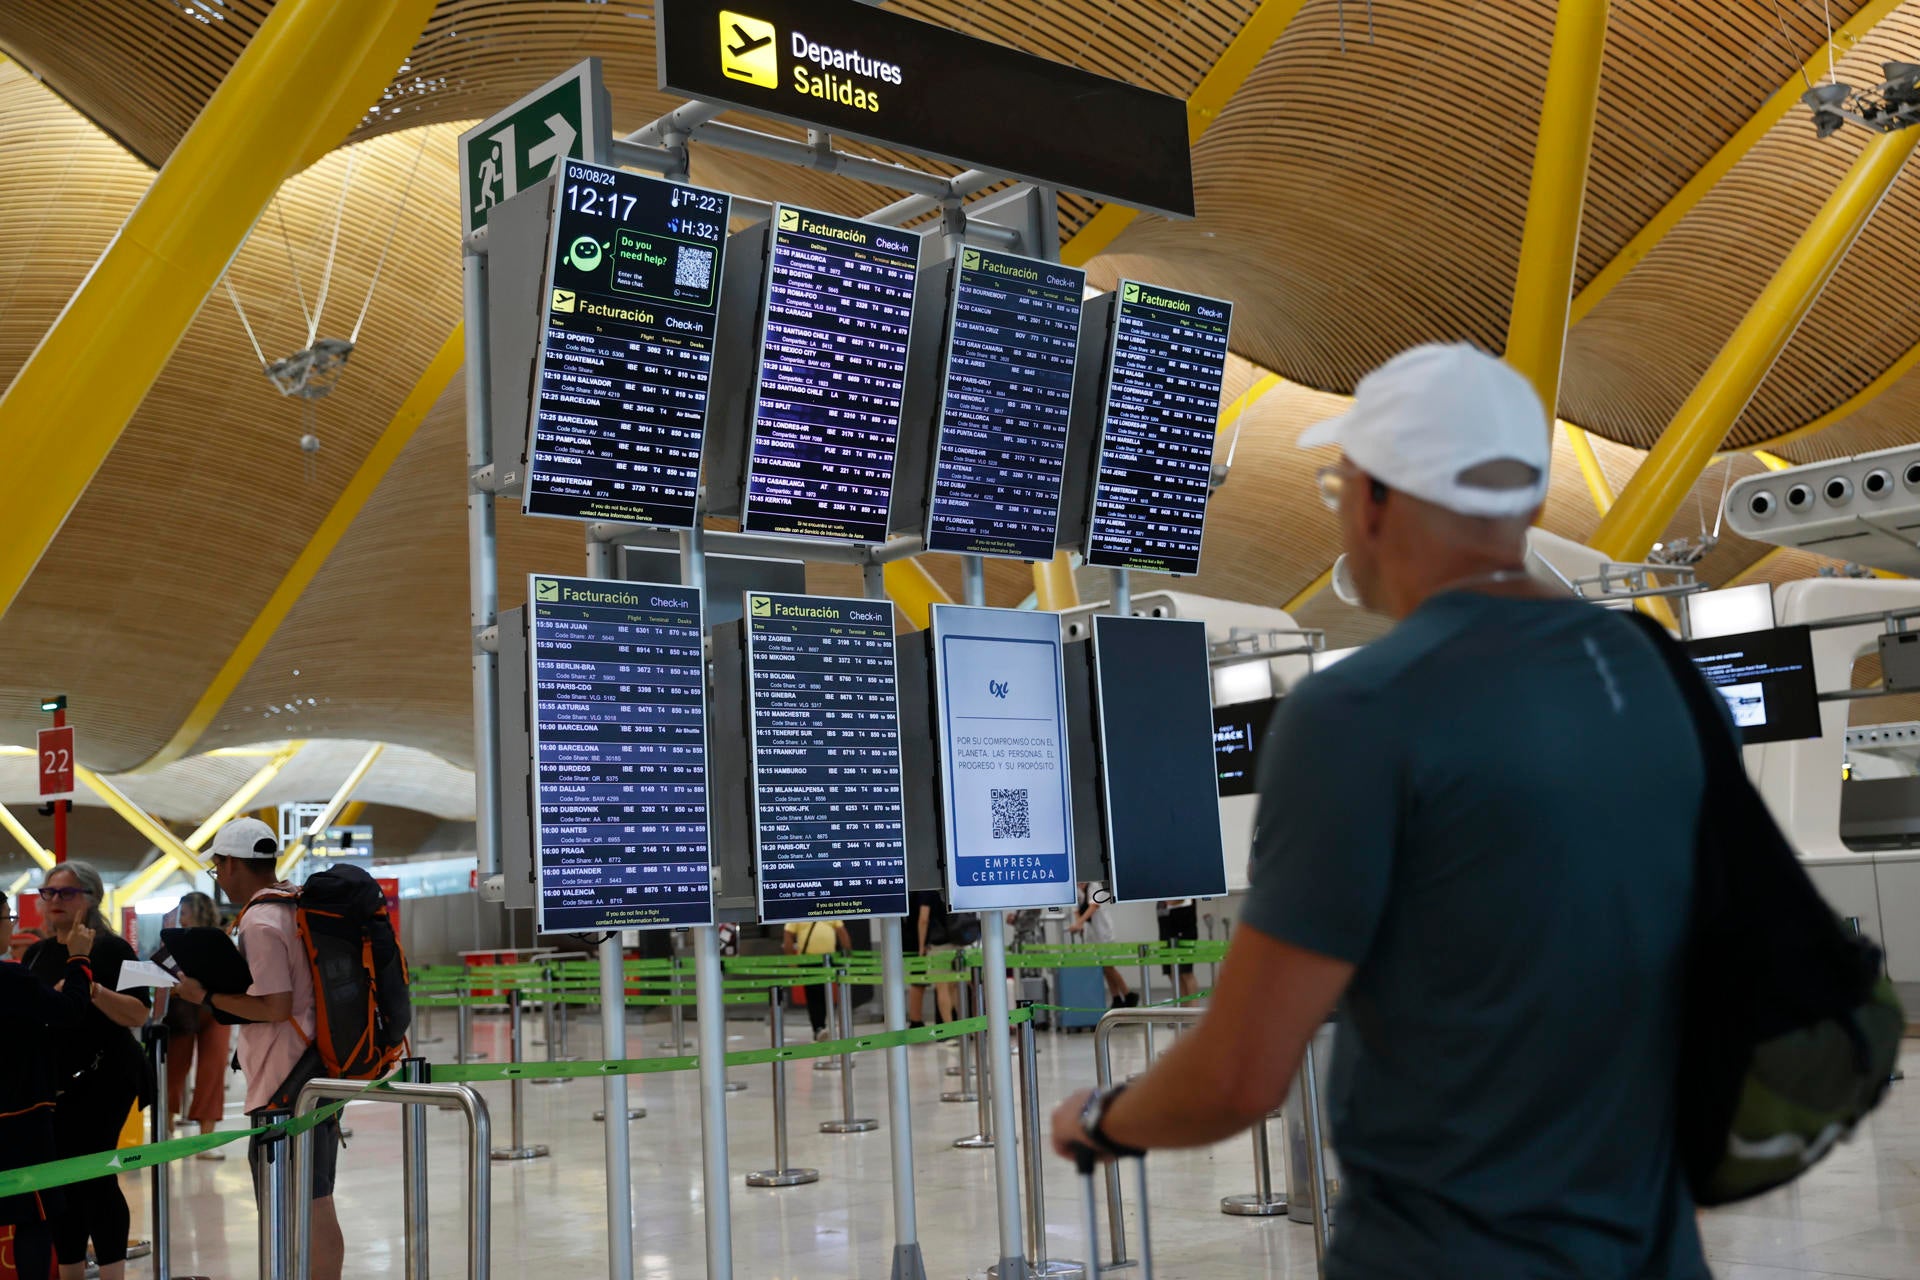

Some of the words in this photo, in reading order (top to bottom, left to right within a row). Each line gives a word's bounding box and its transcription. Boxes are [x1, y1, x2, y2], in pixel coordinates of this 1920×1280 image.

[792, 32, 902, 85] Departures
[794, 66, 880, 112] Salidas
[568, 165, 615, 186] 03/08/24
[565, 183, 637, 223] 12:17
[801, 218, 866, 244] Facturación
[875, 236, 908, 253] Check-in
[621, 236, 636, 247] Do
[635, 240, 651, 251] you
[620, 248, 642, 261] need
[643, 252, 667, 267] help?
[617, 270, 632, 278] Enter
[789, 269, 812, 279] BOSTON
[982, 258, 1038, 280] Facturación
[1046, 274, 1075, 288] Check-in
[616, 277, 630, 285] Aena
[1140, 291, 1190, 312] Facturación
[1197, 305, 1222, 318] Check-in
[784, 307, 812, 318] CARACAS
[970, 306, 991, 314] CANCUN
[578, 299, 654, 325] Facturación
[665, 317, 703, 333] Check-in
[783, 326, 811, 336] SANTIAGO
[566, 333, 594, 343] OPORTO
[781, 345, 802, 354] MEXICO
[981, 344, 1003, 352] CANARIA
[564, 354, 604, 365] GUATEMALA
[577, 376, 611, 386] SALVADOR
[560, 394, 600, 405] BARCELONA
[960, 394, 984, 402] MENORCA
[558, 415, 598, 425] BARCELONA
[555, 435, 591, 445] PAMPLONA
[770, 440, 794, 448] BOGOTA
[553, 455, 581, 464] VENECIA
[551, 476, 592, 486] AMSTERDAM
[766, 477, 804, 487] CASABLANCA
[563, 586, 638, 605] Facturación
[650, 596, 688, 608] Check-in
[774, 603, 839, 618] Facturación
[849, 610, 882, 620] Check-in
[982, 737, 1029, 745] COMPROMISO
[44, 749, 69, 774] 22
[1017, 761, 1054, 769] PROPÓSITO
[984, 856, 1040, 868] EMPRESA
[972, 869, 1054, 882] CERTIFICADA
